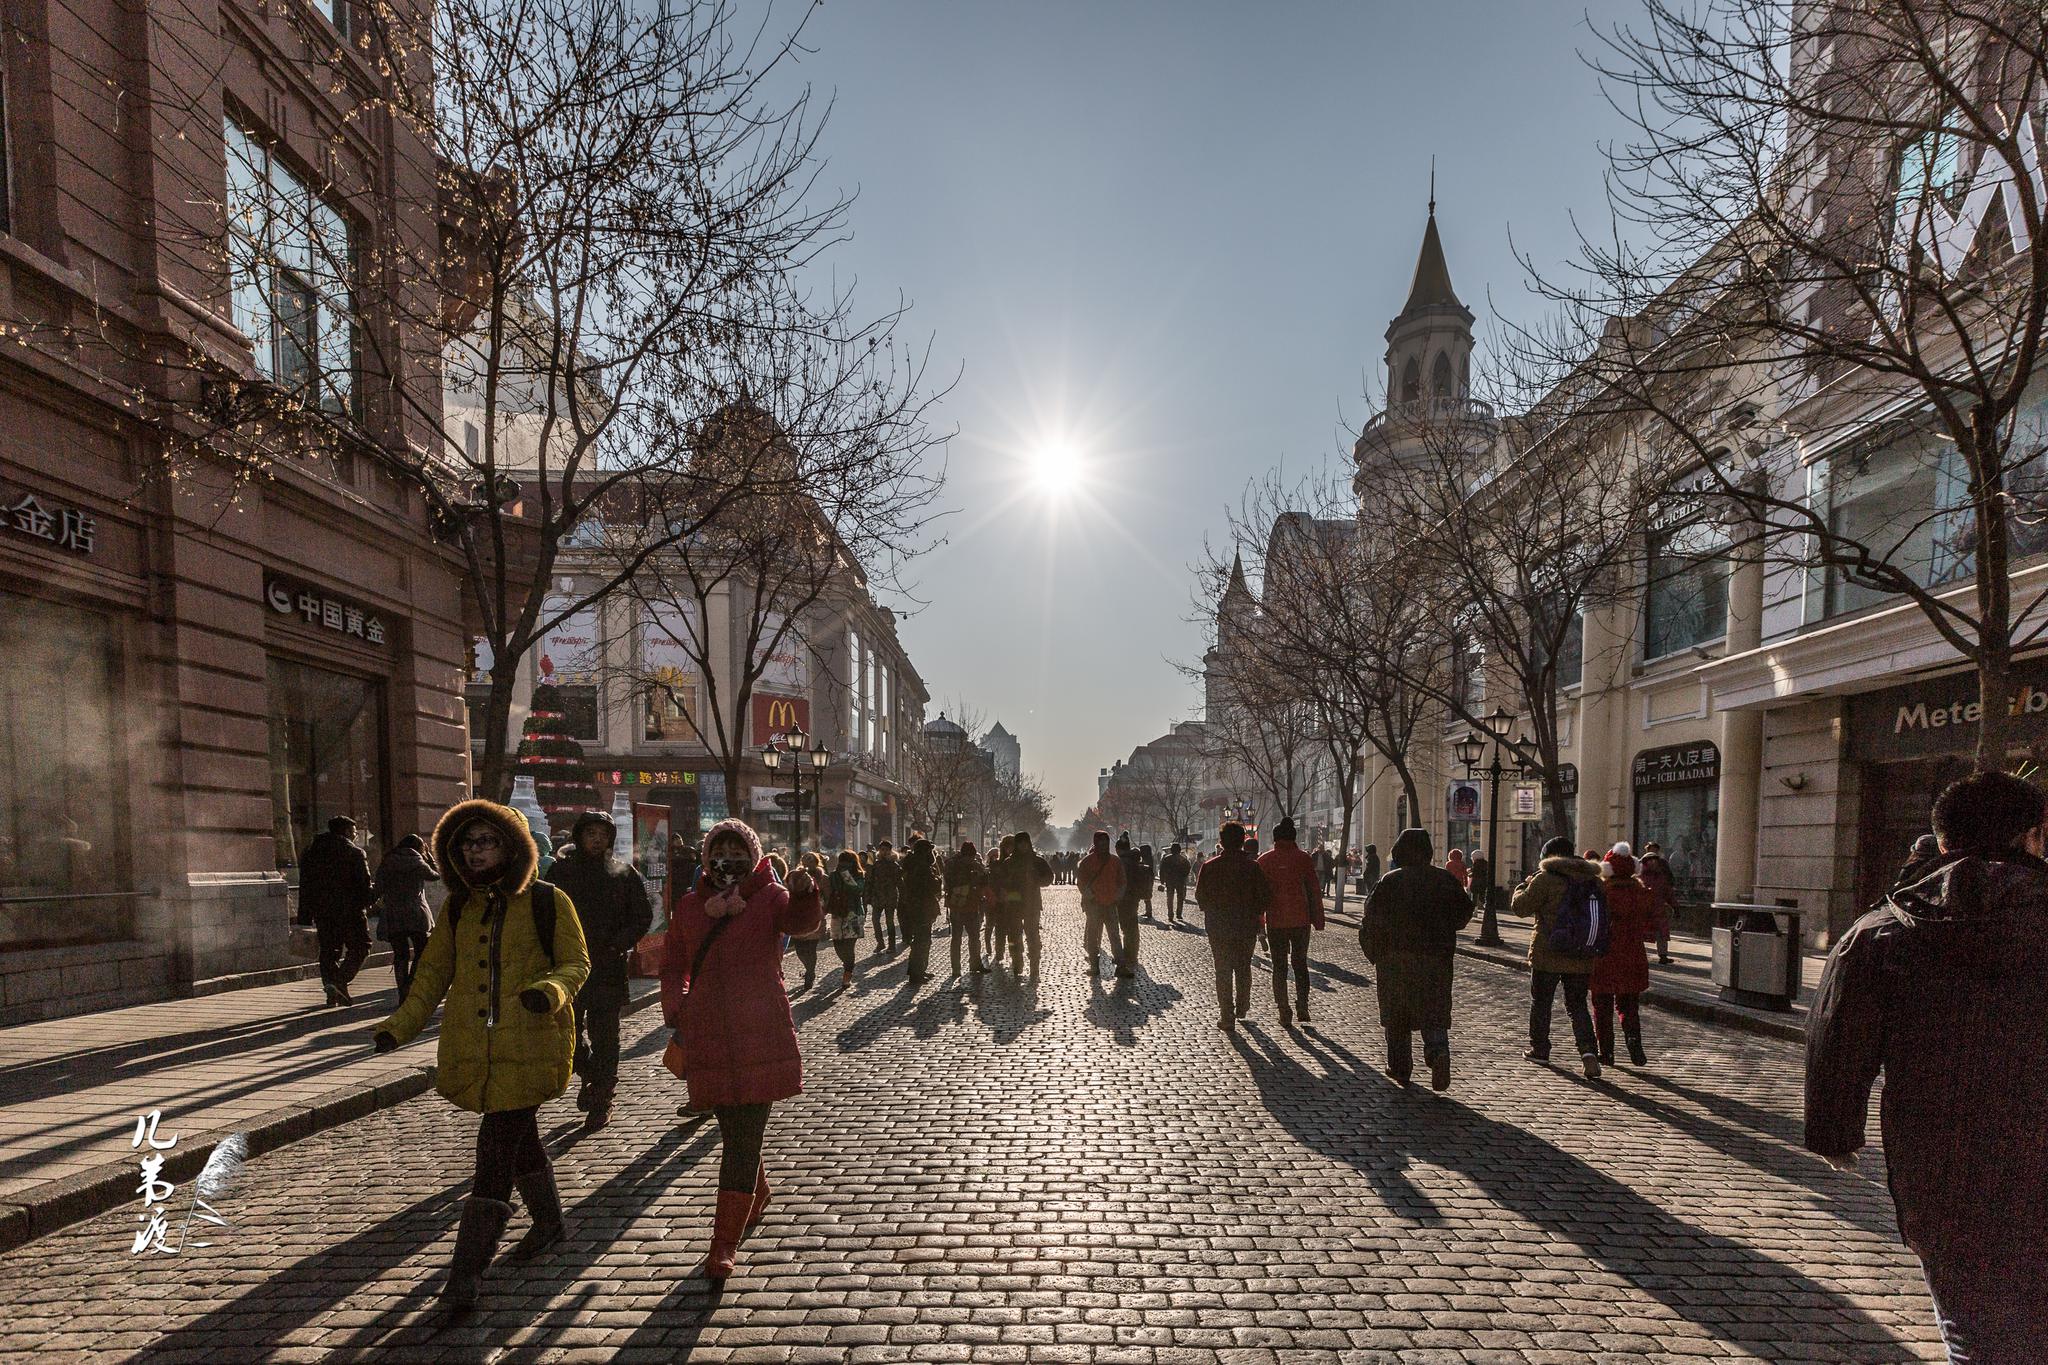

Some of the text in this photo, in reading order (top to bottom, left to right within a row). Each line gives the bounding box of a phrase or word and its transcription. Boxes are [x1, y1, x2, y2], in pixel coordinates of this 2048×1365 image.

[0, 494, 96, 553] 金店
[299, 591, 385, 645] 中国黄金
[595, 770, 696, 785] 儿童主题游乐园
[1678, 766, 1715, 780] MADAM
